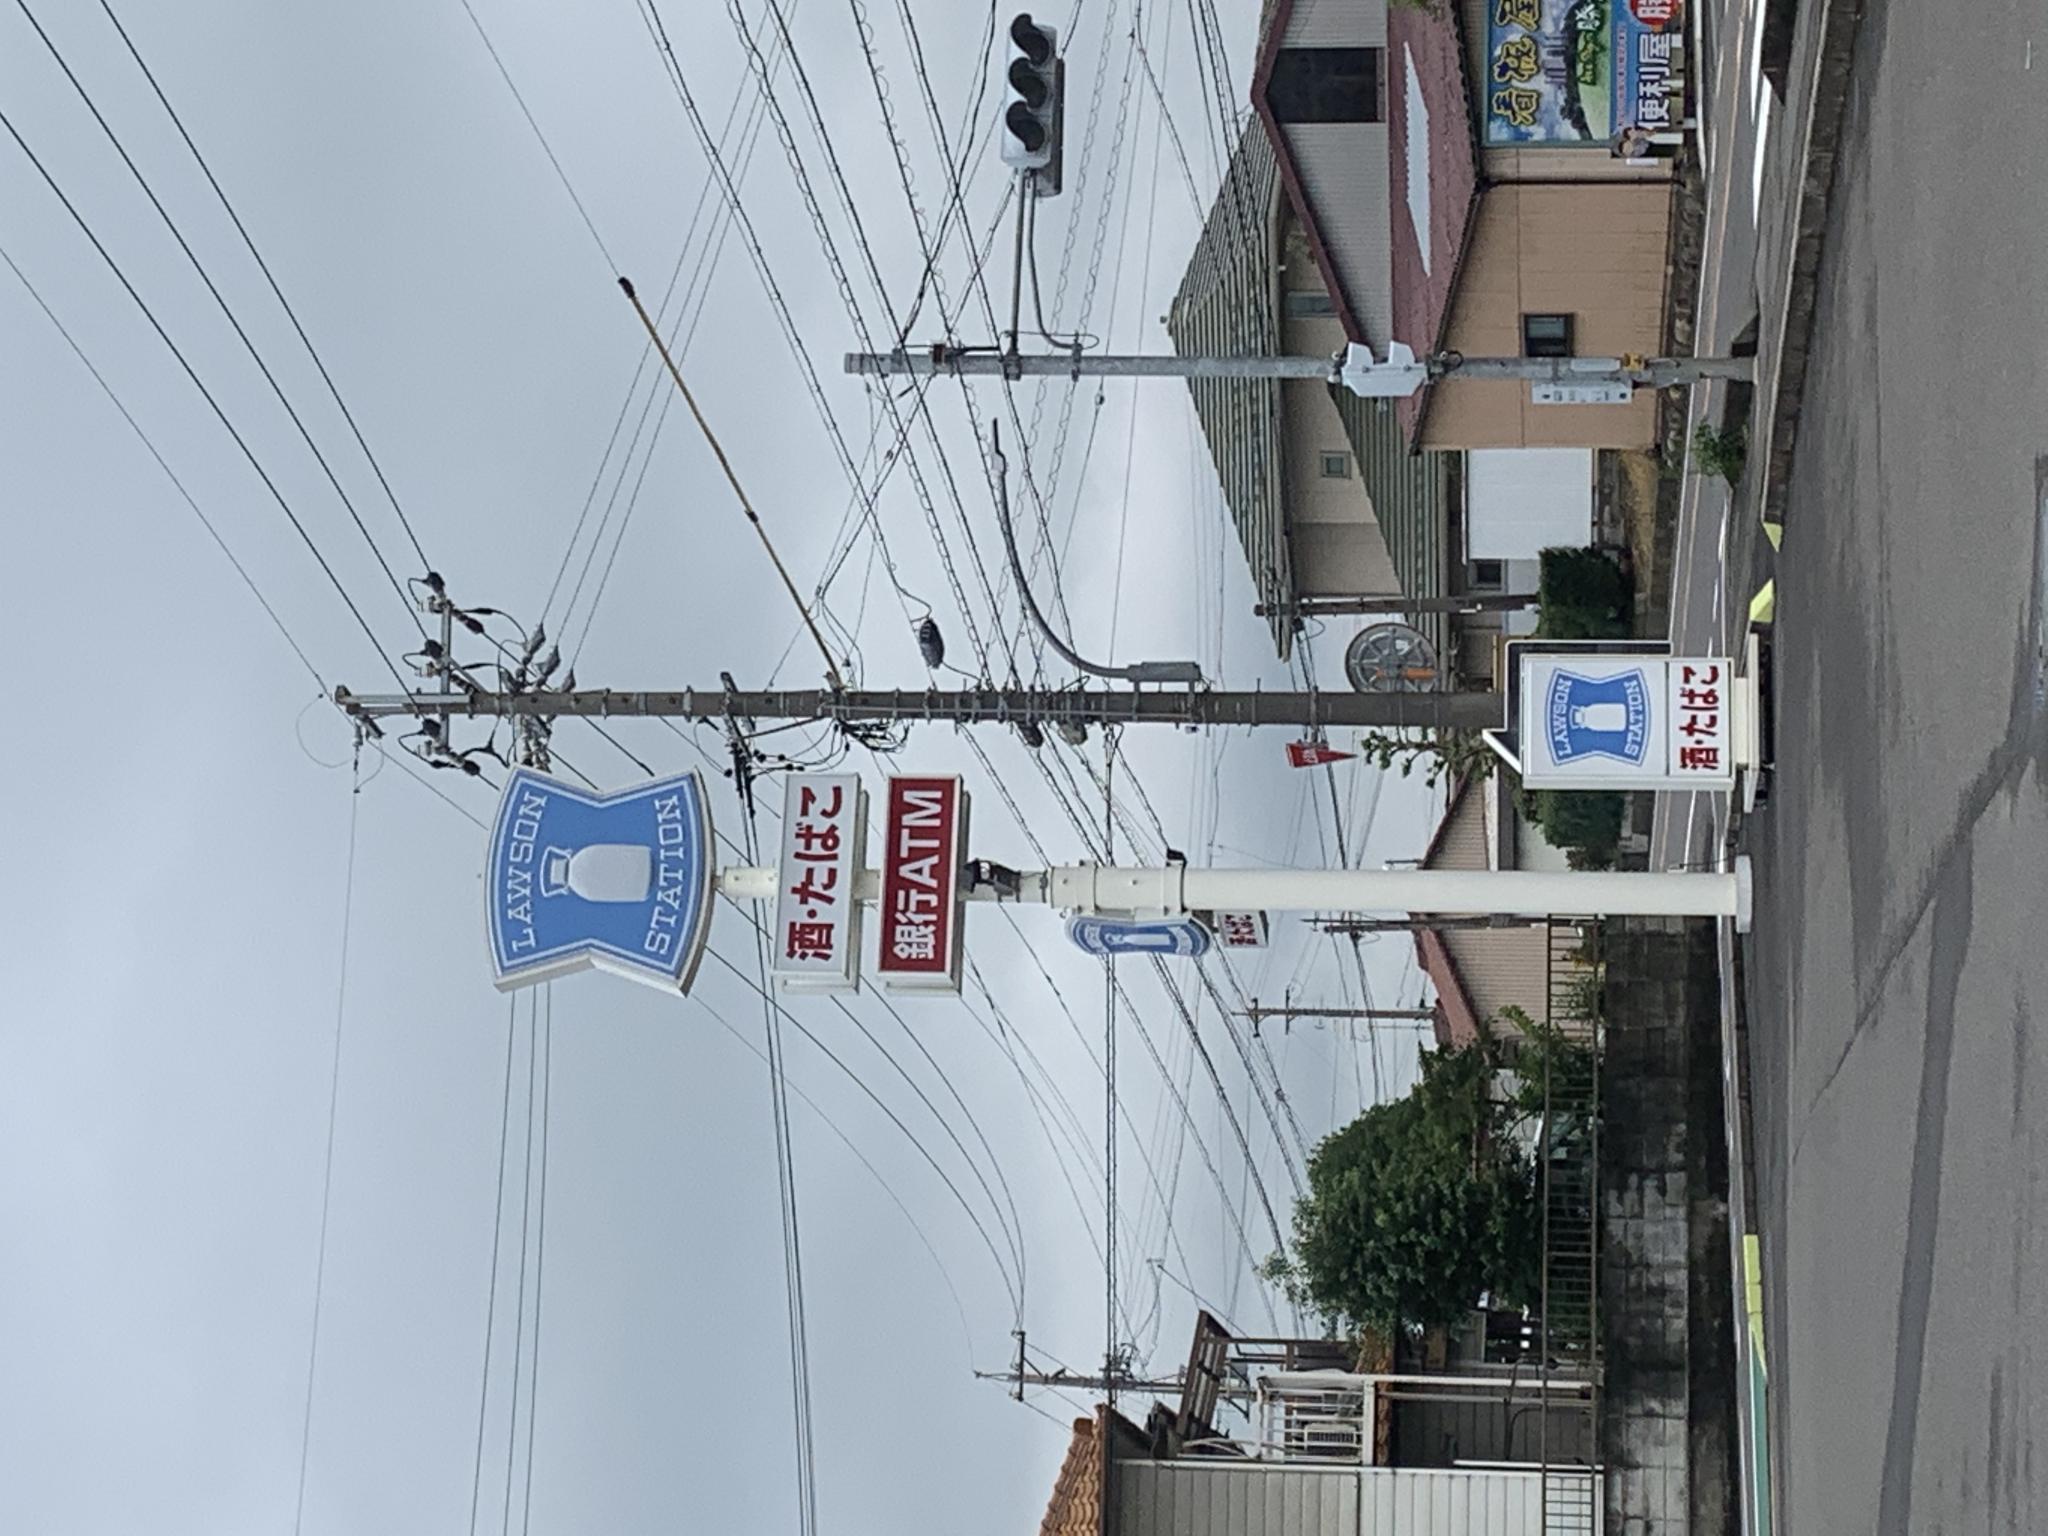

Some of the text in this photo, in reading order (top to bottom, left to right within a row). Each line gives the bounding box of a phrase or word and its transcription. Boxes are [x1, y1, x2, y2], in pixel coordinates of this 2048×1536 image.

[1637, 33, 1670, 129] 便利屋
[1552, 678, 1571, 756] LAWSON
[1623, 679, 1642, 757] STATION
[1679, 665, 1719, 770] 酒・たばこ
[506, 790, 547, 951] LAWSON
[644, 795, 685, 955] STATION
[786, 785, 842, 961] 酒・たばこ
[894, 789, 943, 960] 銀行ATM
